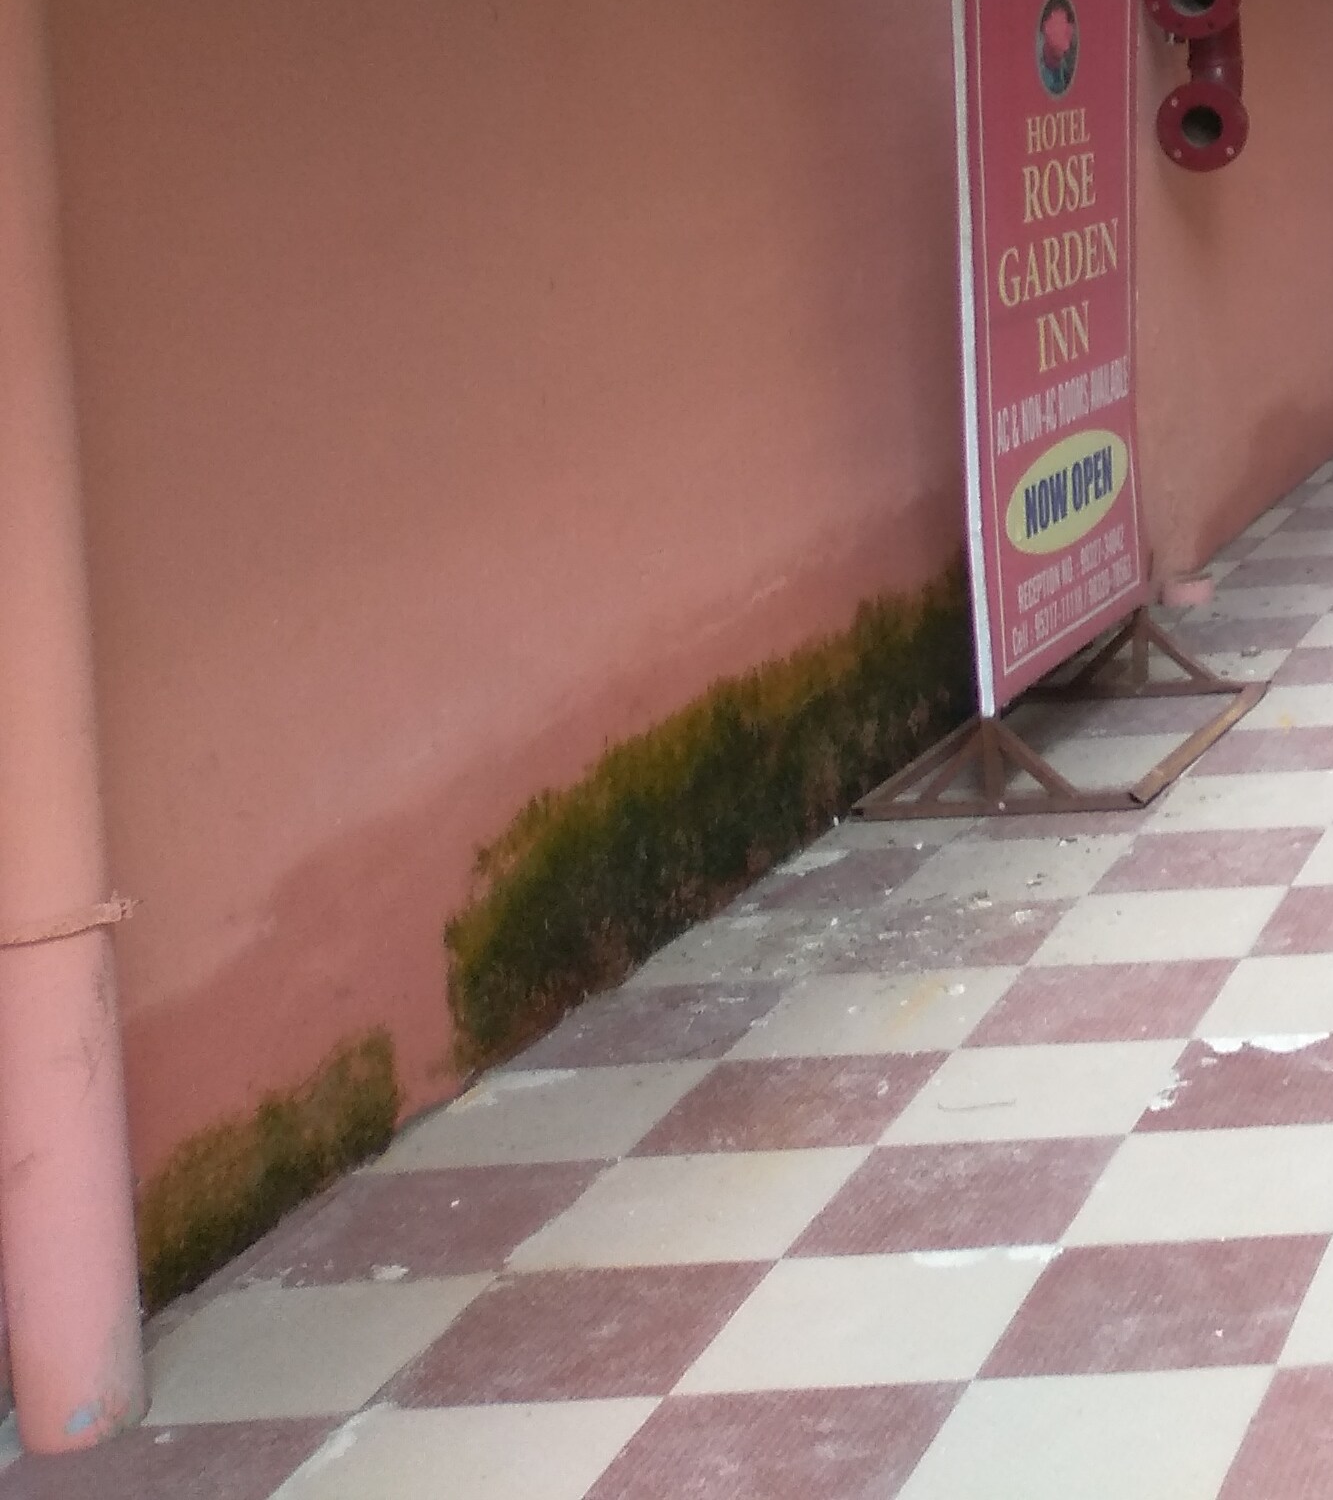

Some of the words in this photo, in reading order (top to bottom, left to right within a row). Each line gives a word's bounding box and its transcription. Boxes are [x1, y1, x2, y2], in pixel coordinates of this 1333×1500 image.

[1027, 108, 1090, 154] HOTEL
[1023, 153, 1096, 223] ROSE
[999, 217, 1118, 307] GARDEN
[1037, 300, 1090, 373] INN
[1025, 467, 1068, 539] NOW
[1071, 445, 1113, 513] OPEN
[1018, 564, 1060, 615] RECEPTION
